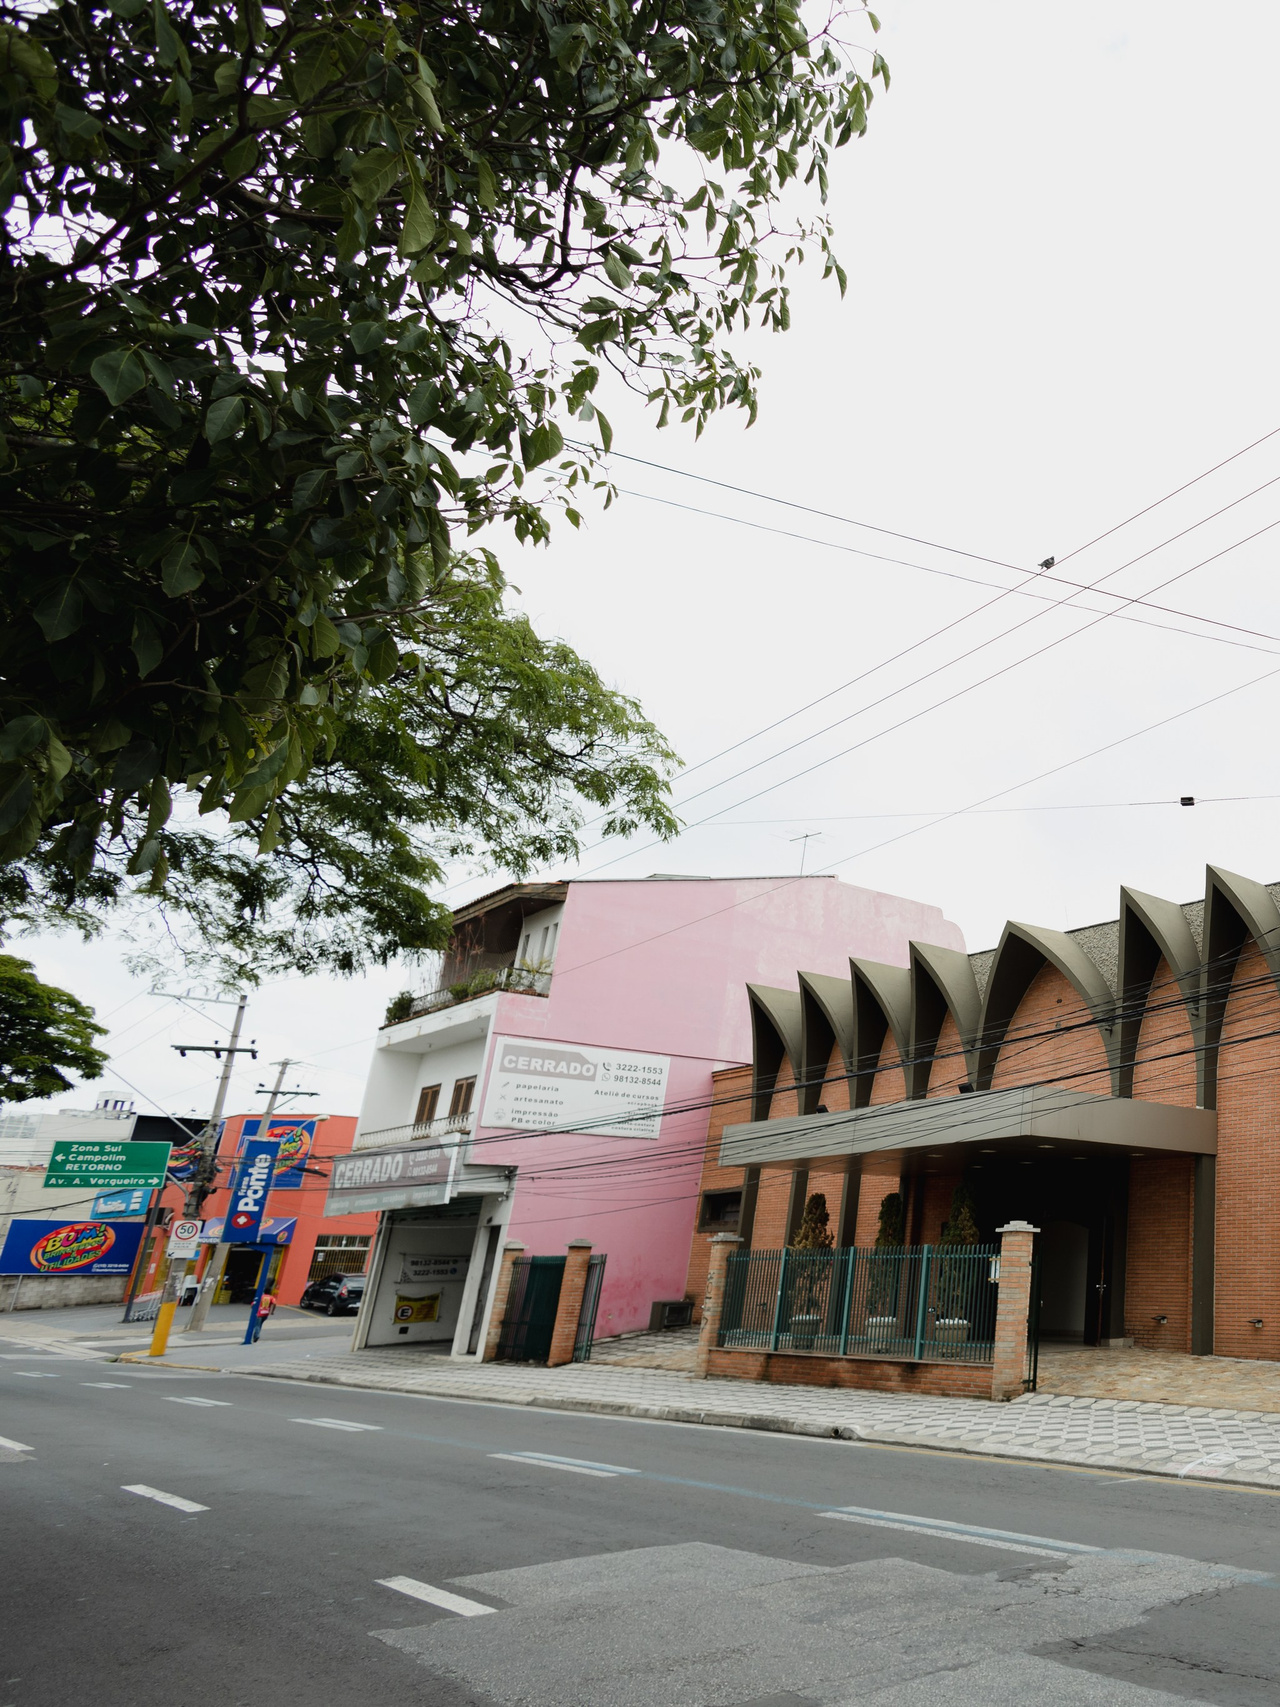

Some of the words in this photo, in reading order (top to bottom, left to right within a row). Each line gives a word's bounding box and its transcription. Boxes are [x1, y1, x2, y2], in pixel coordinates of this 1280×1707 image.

[503, 1055, 595, 1077] CERRADO
[615, 1063, 663, 1075] 3222-1553
[613, 1074, 662, 1086] 98132-8544
[515, 1082, 559, 1092] papelaria
[513, 1096, 564, 1105] artesanato
[632, 1093, 659, 1101] cursos
[511, 1108, 558, 1118] impressão
[532, 1118, 556, 1126] color
[70, 1144, 100, 1152] Zona
[104, 1144, 122, 1152] Sul
[68, 1153, 126, 1162] Campolim
[65, 1163, 122, 1171] RETORNO
[334, 1153, 403, 1189] CERRADO
[48, 1177, 67, 1185] Av.
[72, 1177, 84, 1185] A.
[90, 1177, 145, 1186] Vergueiro
[237, 1153, 272, 1212] Ponte
[179, 1225, 194, 1235] 50
[44, 1223, 107, 1252] BOM!
[39, 1249, 102, 1273] UTILIDADES
[400, 1308, 410, 1317] E
